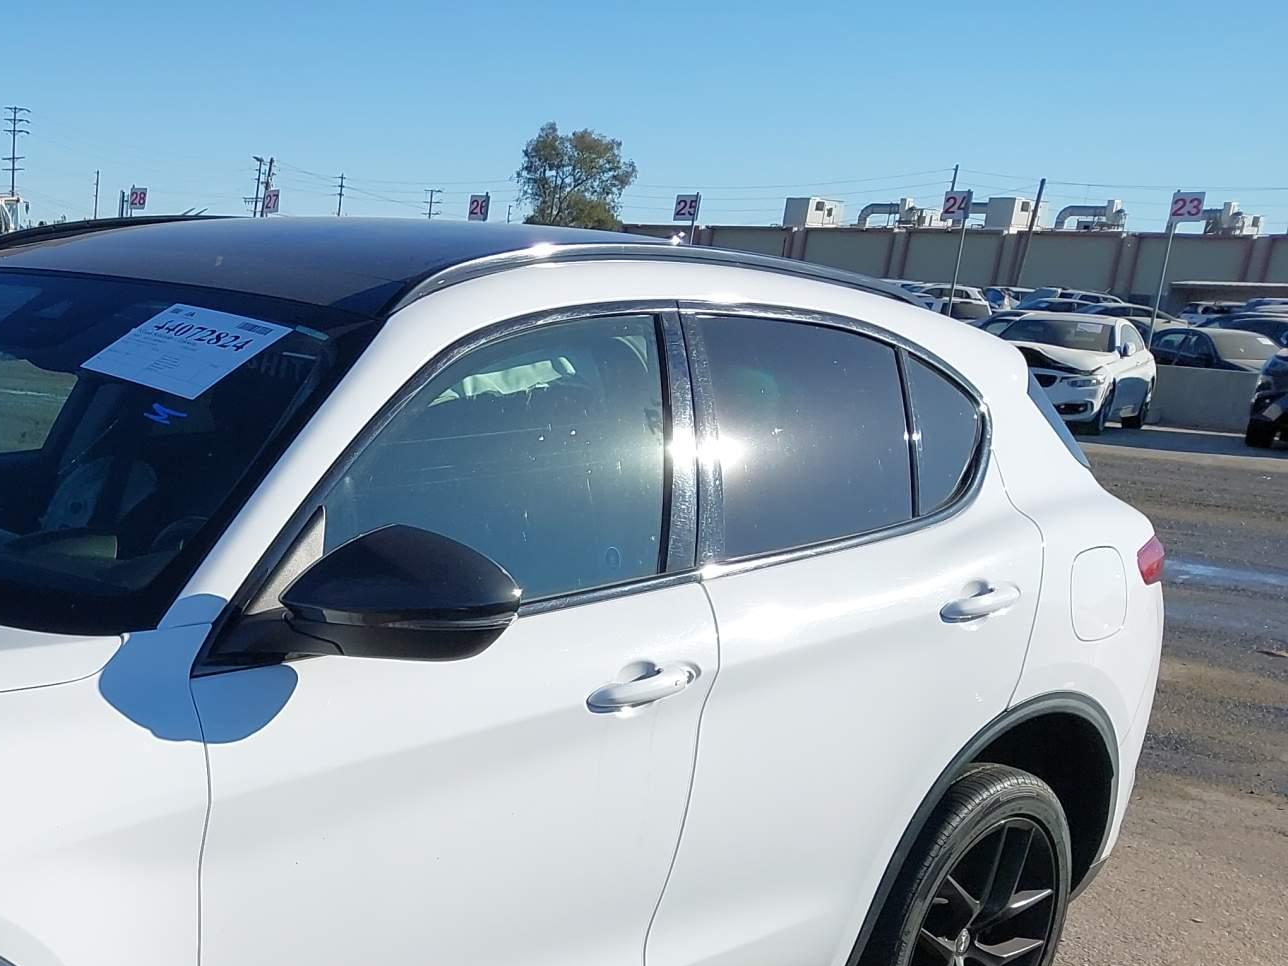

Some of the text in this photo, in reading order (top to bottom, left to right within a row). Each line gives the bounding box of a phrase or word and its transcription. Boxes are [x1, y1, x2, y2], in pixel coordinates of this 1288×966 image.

[129, 191, 146, 206] 28
[264, 193, 279, 209] 27
[675, 199, 697, 216] 25
[943, 195, 969, 215] 24
[1171, 197, 1202, 217] 23
[153, 319, 254, 353] 44072824
